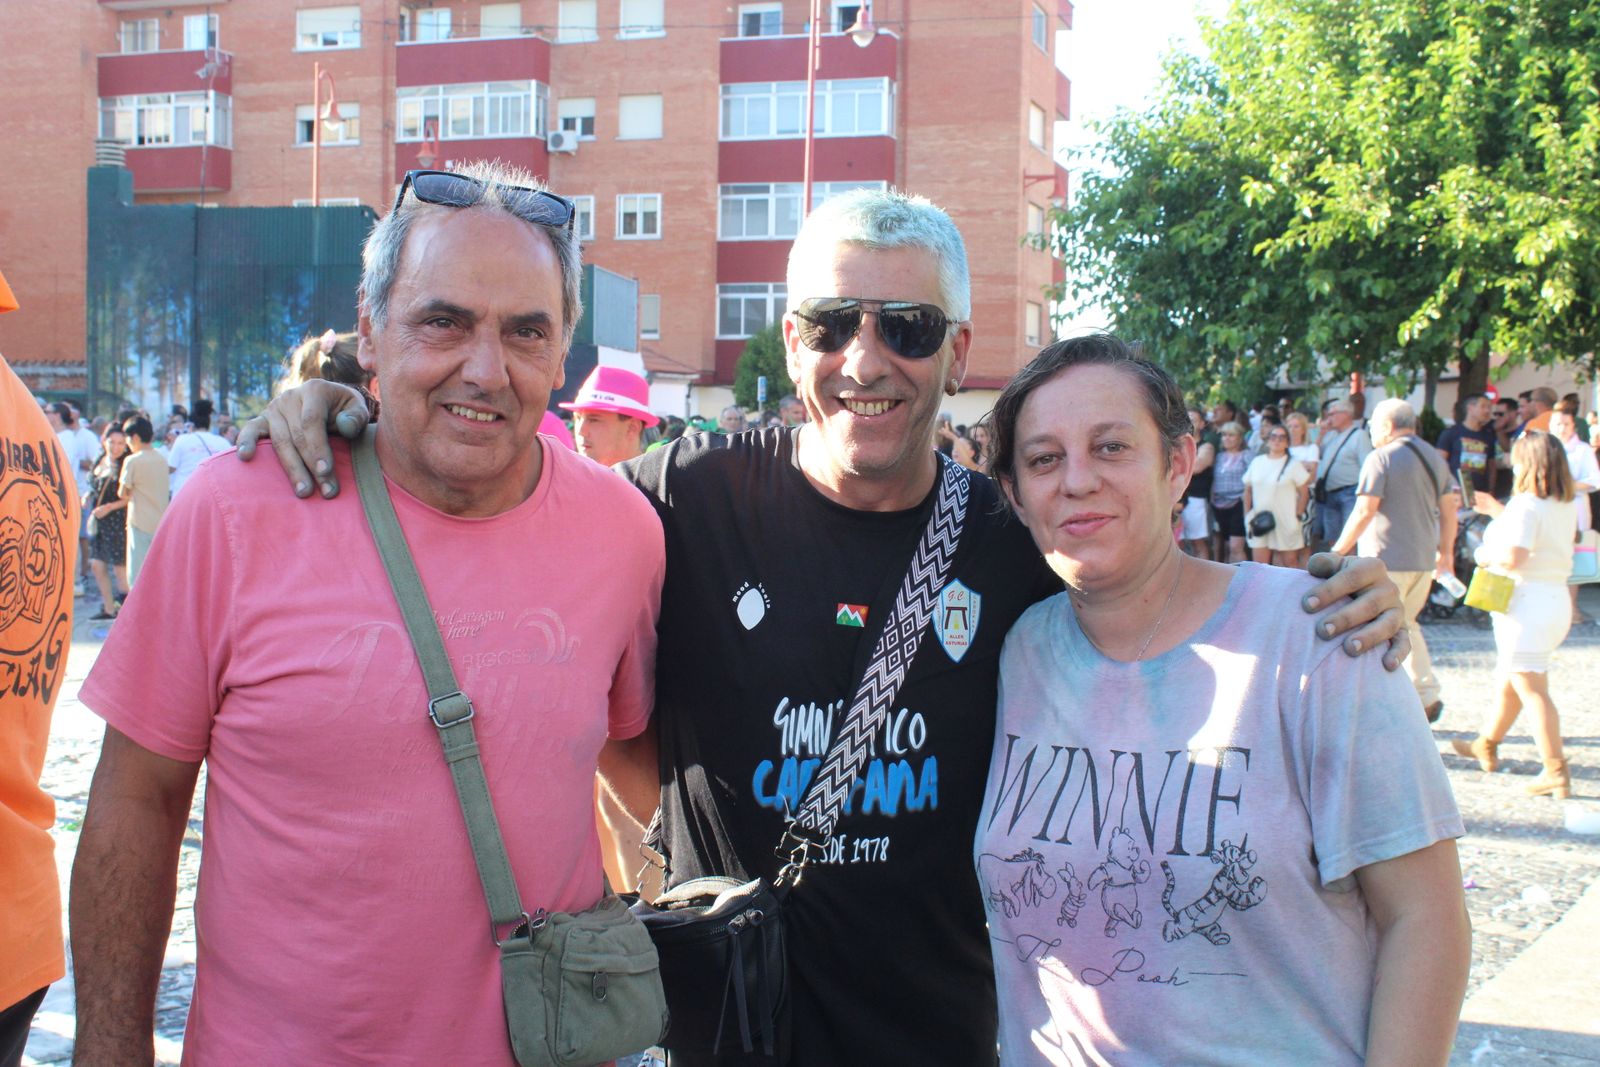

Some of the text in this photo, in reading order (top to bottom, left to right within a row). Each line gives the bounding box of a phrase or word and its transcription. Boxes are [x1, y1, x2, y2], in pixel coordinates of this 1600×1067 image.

[732, 581, 750, 603] mood
[987, 734, 1251, 857] WINNIE
[850, 836, 890, 863] 1978
[1081, 947, 1189, 988] Pooh
